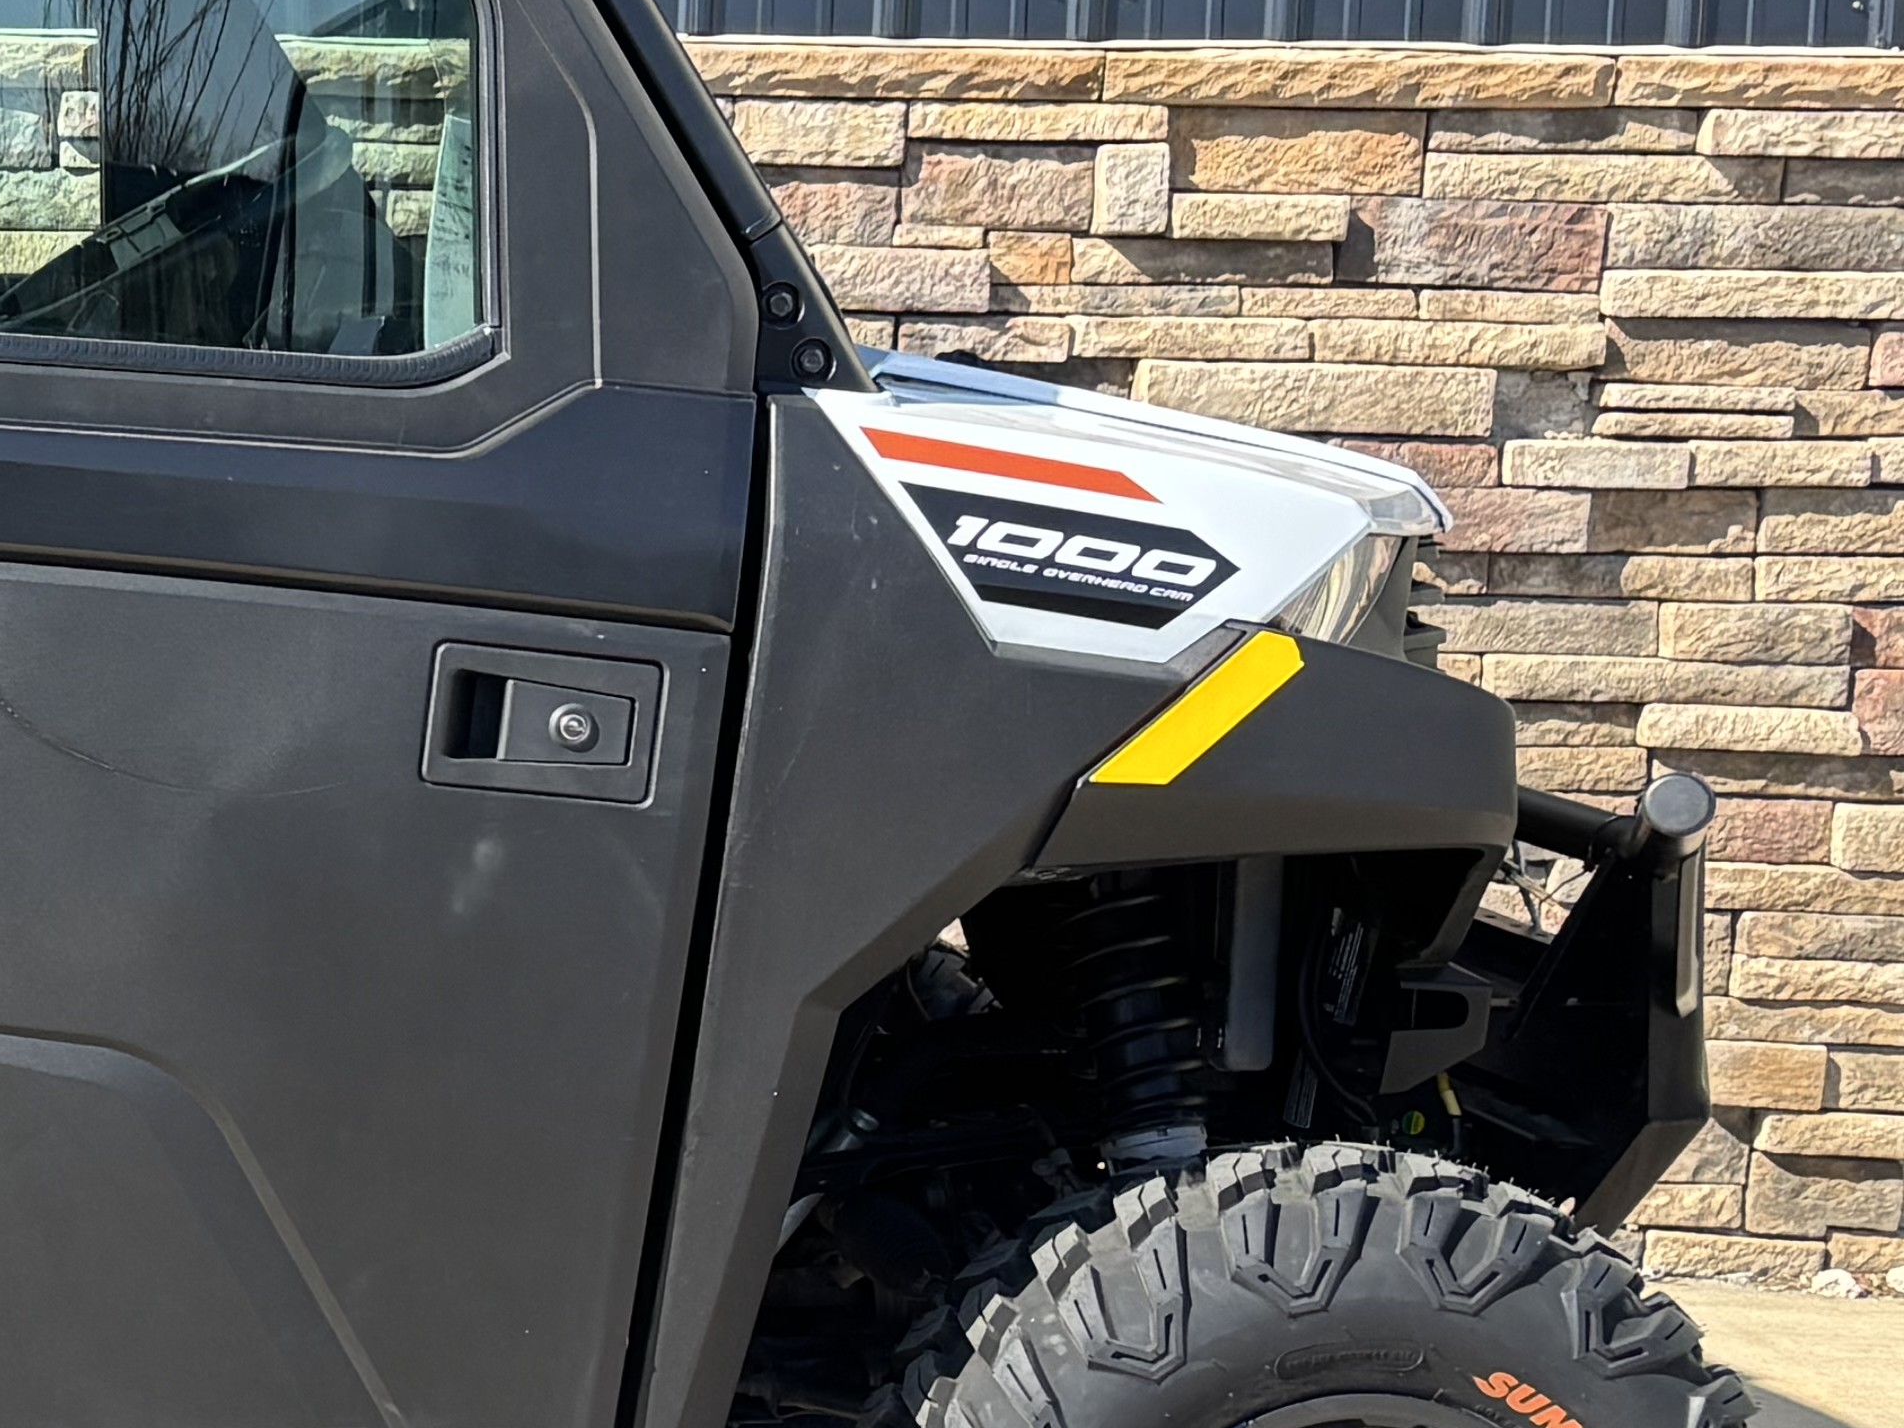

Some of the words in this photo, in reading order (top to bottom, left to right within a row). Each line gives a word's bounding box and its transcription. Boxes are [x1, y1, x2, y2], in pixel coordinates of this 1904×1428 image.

[947, 514, 1216, 587] 1000
[962, 553, 1040, 574] SINGLE
[1042, 567, 1149, 594] OVERHEAD
[1149, 587, 1195, 602] CAM
